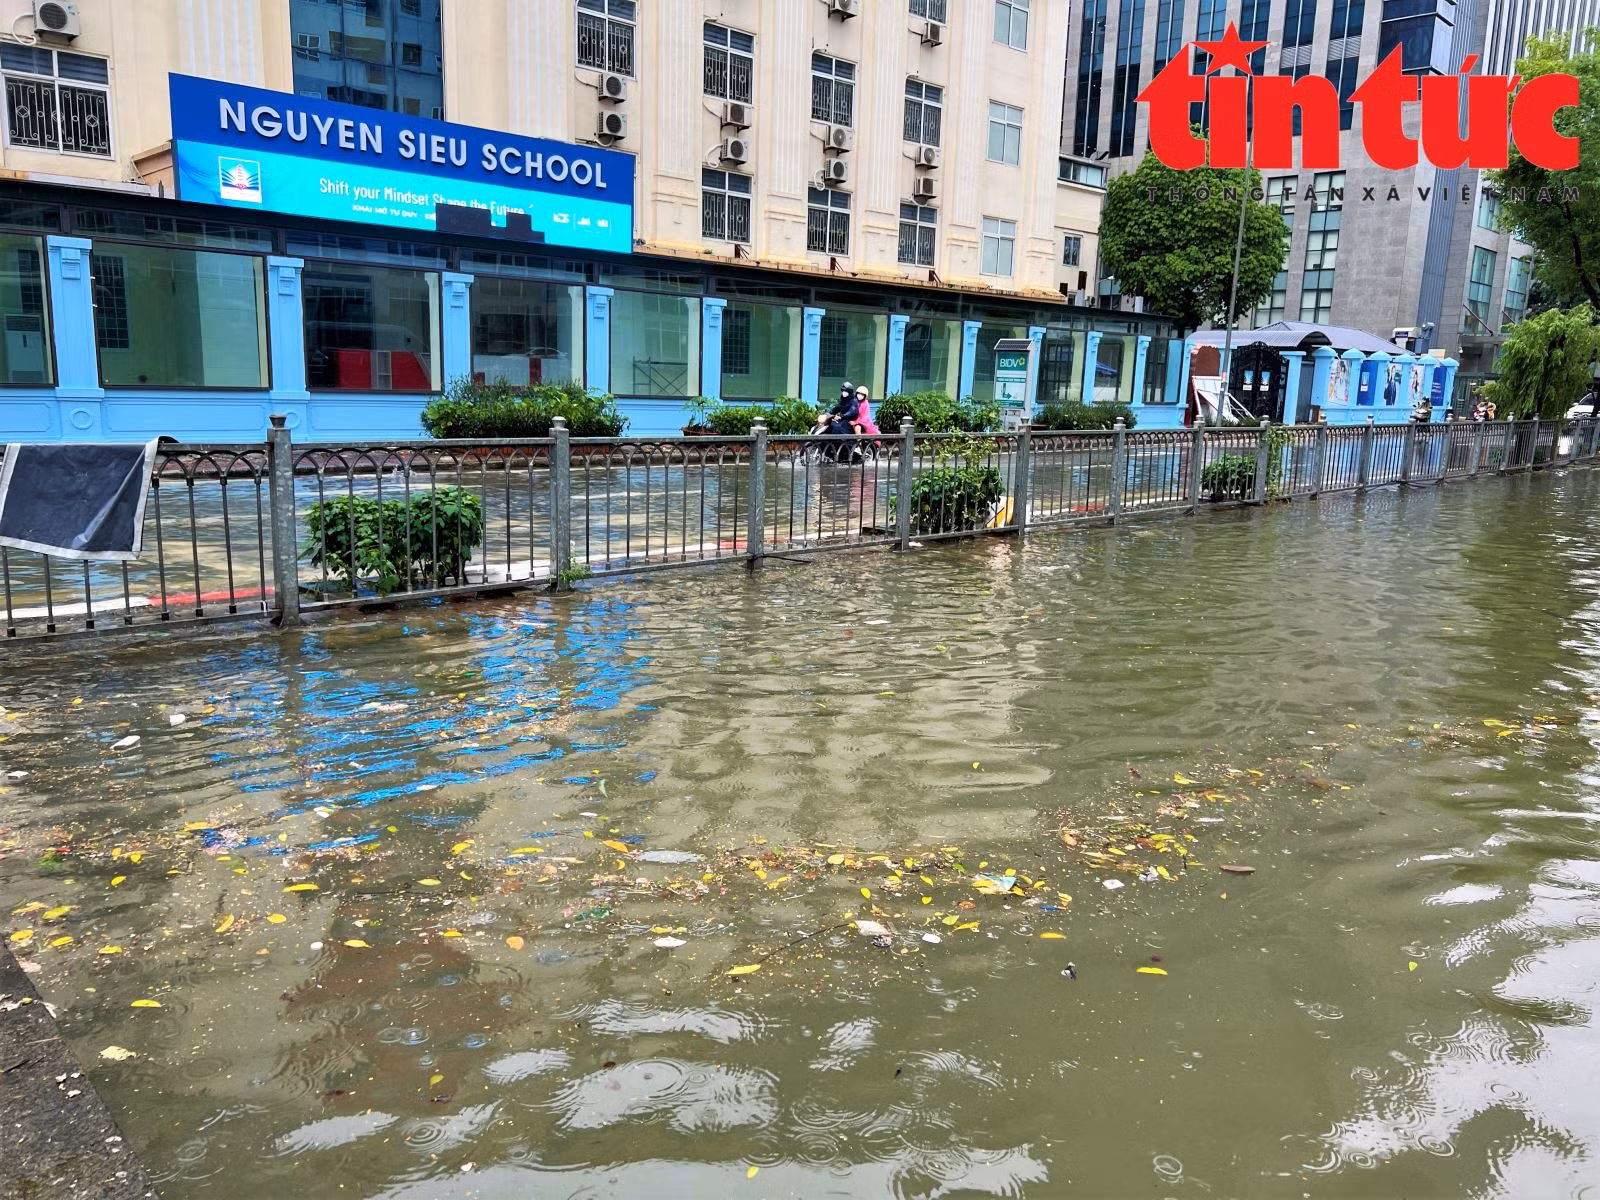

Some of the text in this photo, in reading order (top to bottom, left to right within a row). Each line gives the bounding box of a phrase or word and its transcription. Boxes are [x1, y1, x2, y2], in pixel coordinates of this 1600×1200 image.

[219, 98, 608, 190] NGUYEN SIEU SCHOOL
[319, 178, 350, 196] Shift
[353, 186, 381, 201] your
[384, 187, 430, 207] Mindset
[999, 358, 1019, 368] BIDV
